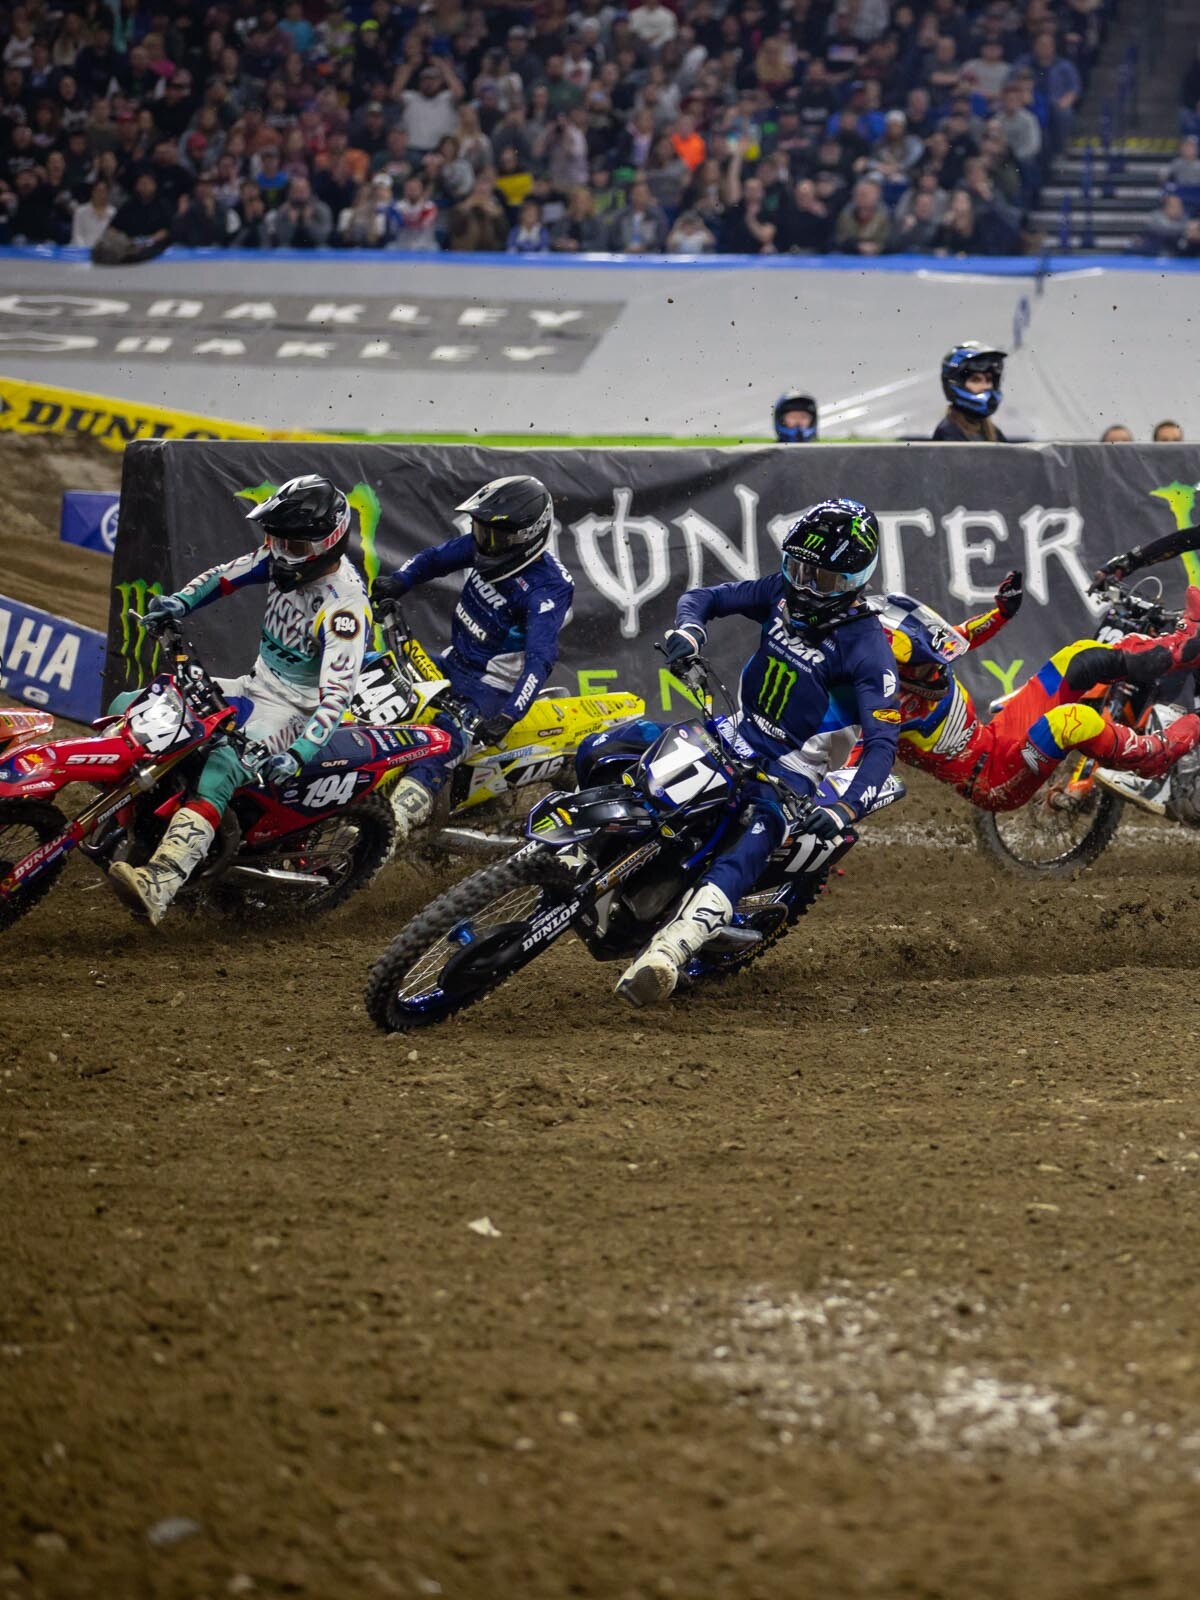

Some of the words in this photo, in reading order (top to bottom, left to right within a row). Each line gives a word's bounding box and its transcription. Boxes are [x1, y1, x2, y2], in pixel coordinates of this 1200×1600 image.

[452, 484, 1112, 638] ONTER
[333, 616, 357, 633] 194
[455, 602, 487, 641] SUZUKI
[358, 668, 411, 726] 446
[514, 672, 540, 711] THOR
[302, 771, 359, 808] 194
[14, 832, 68, 881] DUNLO
[522, 899, 582, 953] DUNLOP
